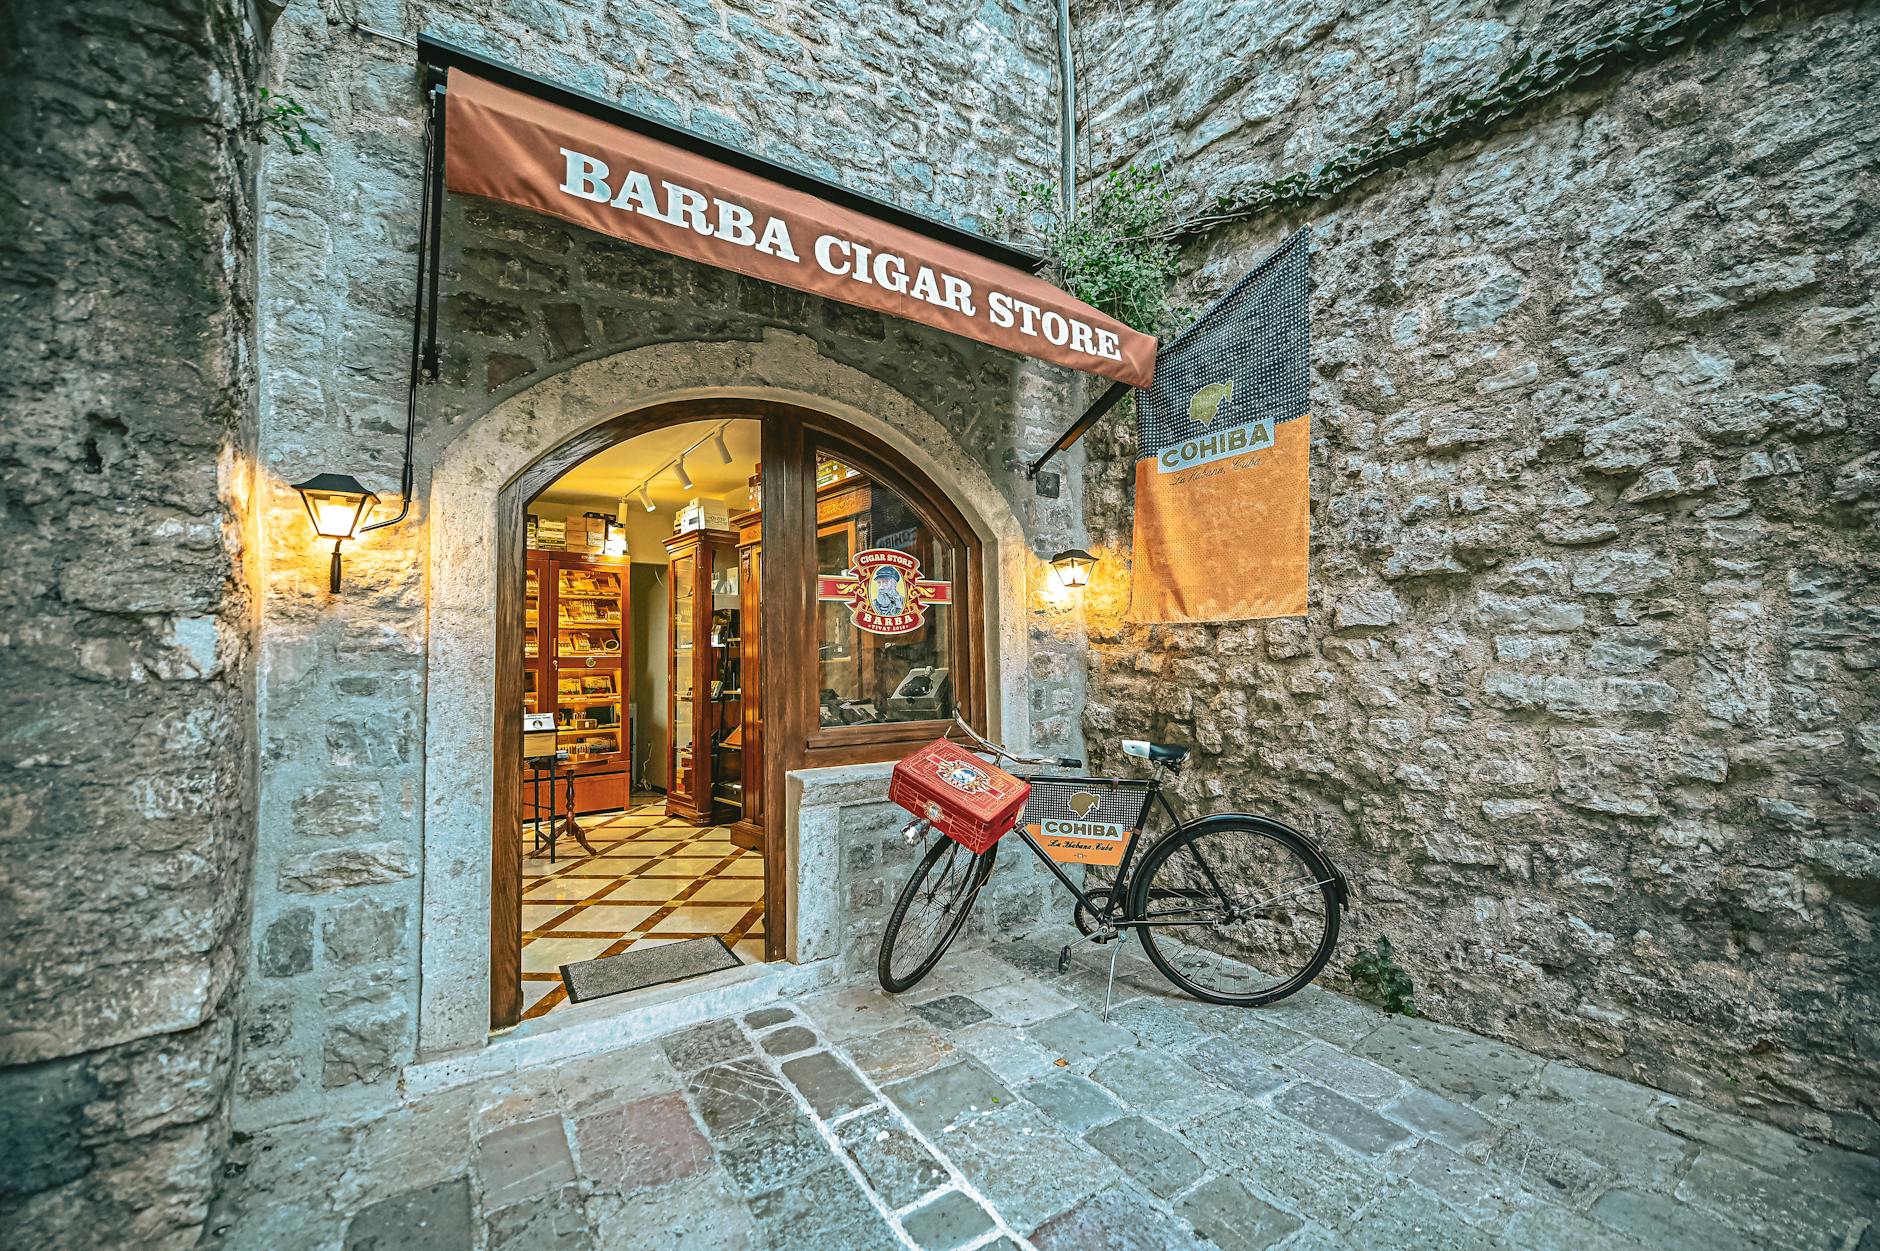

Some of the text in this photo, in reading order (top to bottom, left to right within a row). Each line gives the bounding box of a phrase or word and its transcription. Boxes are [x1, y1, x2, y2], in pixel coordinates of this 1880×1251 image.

[560, 147, 1122, 361] BARBA CIGAR STORE
[1161, 423, 1270, 468] COHIBA
[860, 554, 913, 568] CIGAR STORE
[863, 613, 914, 626] BARBA
[1044, 821, 1119, 838] COHIBA
